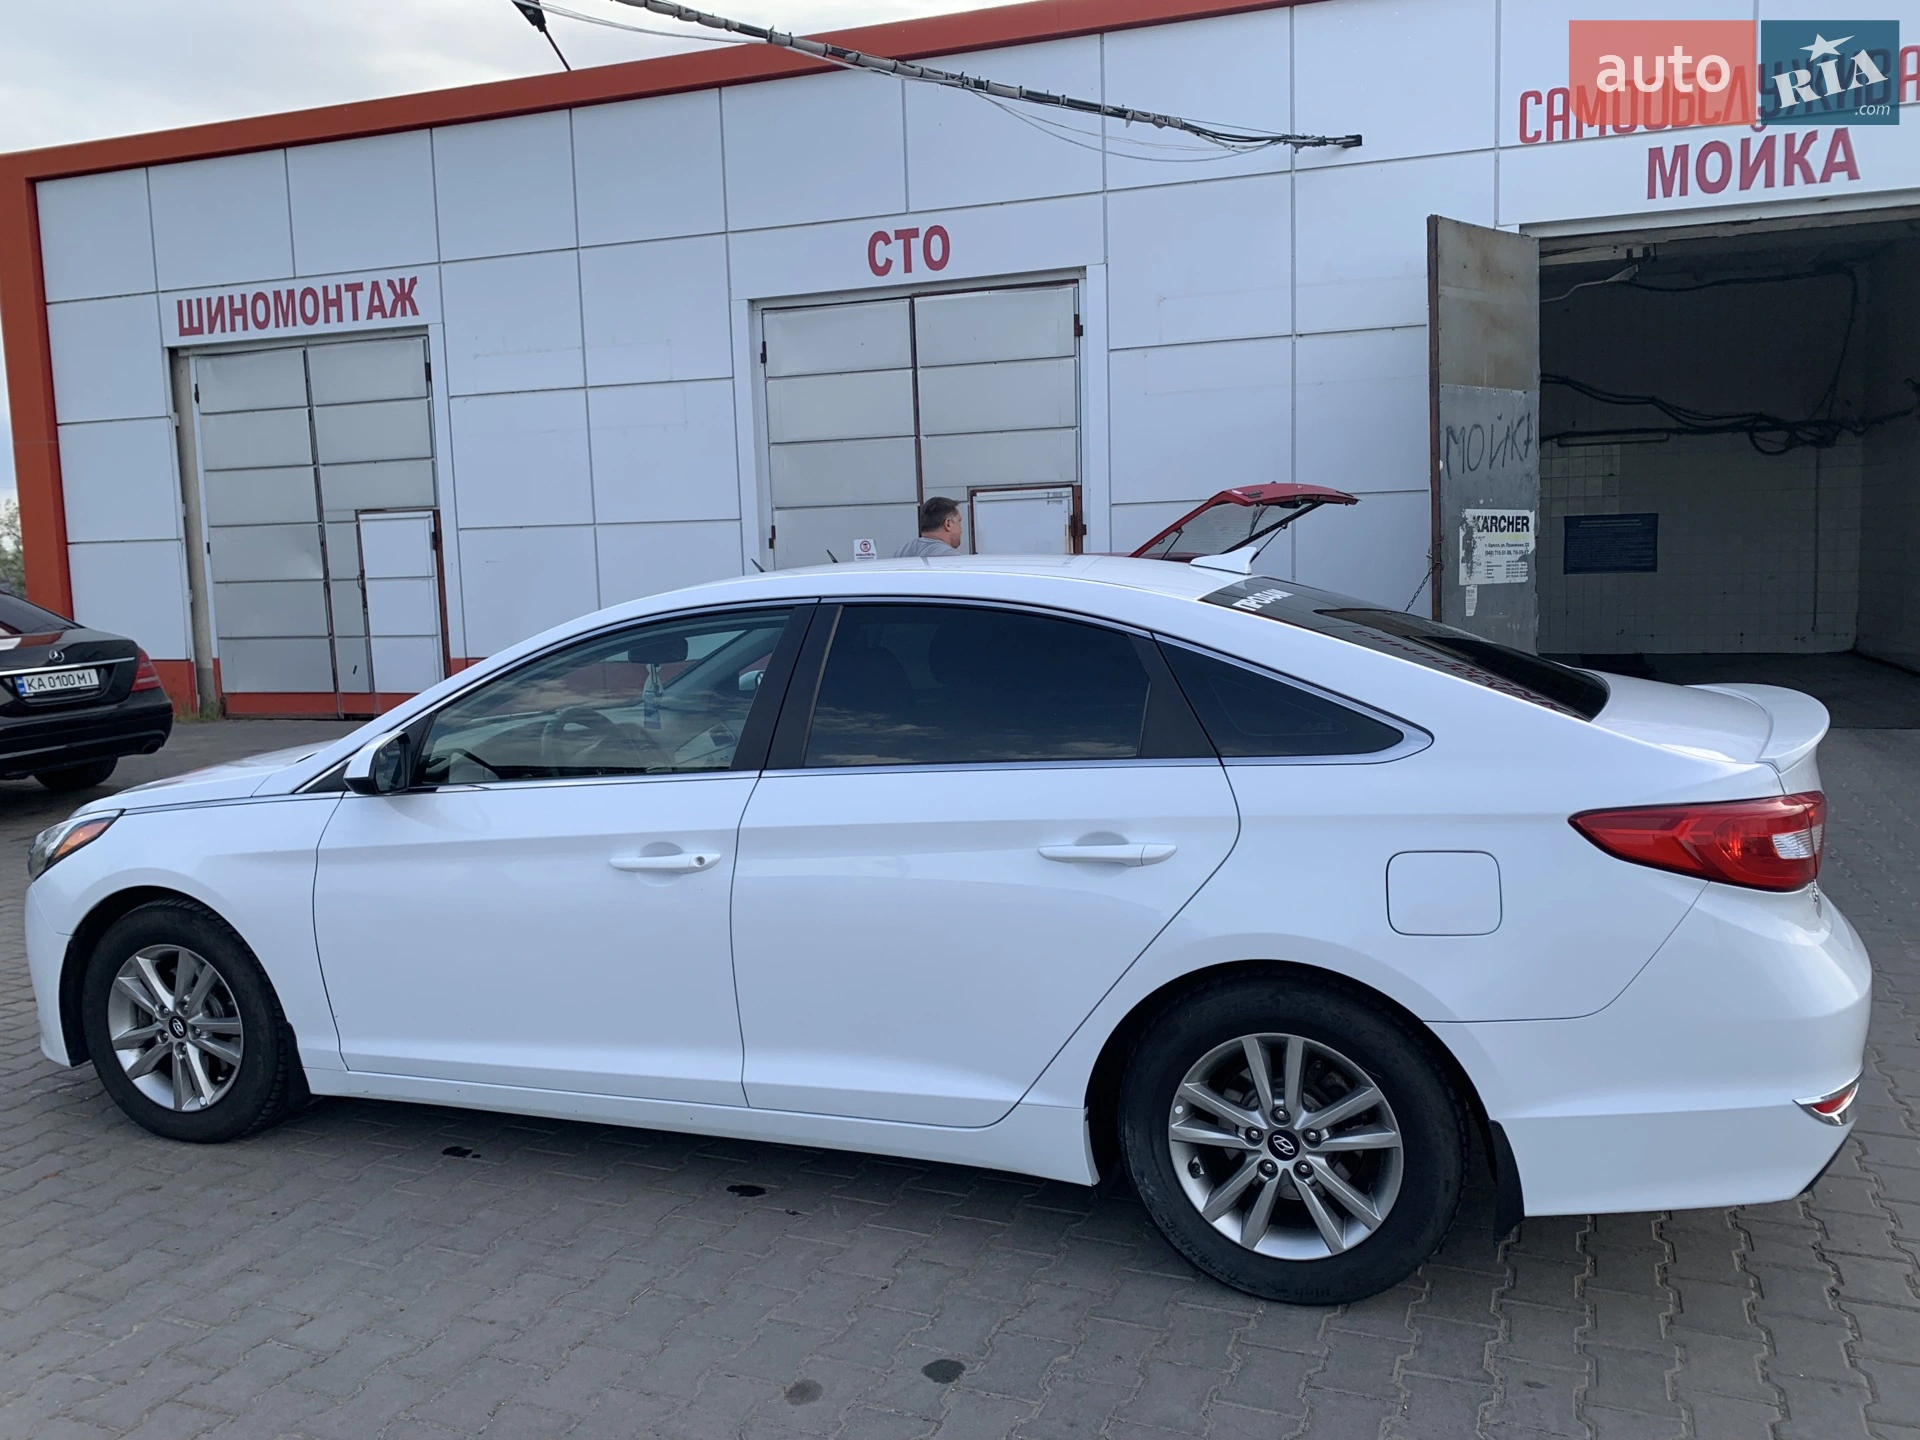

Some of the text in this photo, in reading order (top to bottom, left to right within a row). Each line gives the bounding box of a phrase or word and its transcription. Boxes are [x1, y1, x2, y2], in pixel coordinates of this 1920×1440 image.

[1647, 124, 1861, 200] МОЙКА
[868, 225, 950, 277] СТО
[177, 276, 420, 337] ШИНОМОНТАЖ
[48, 674, 76, 688] 0100
